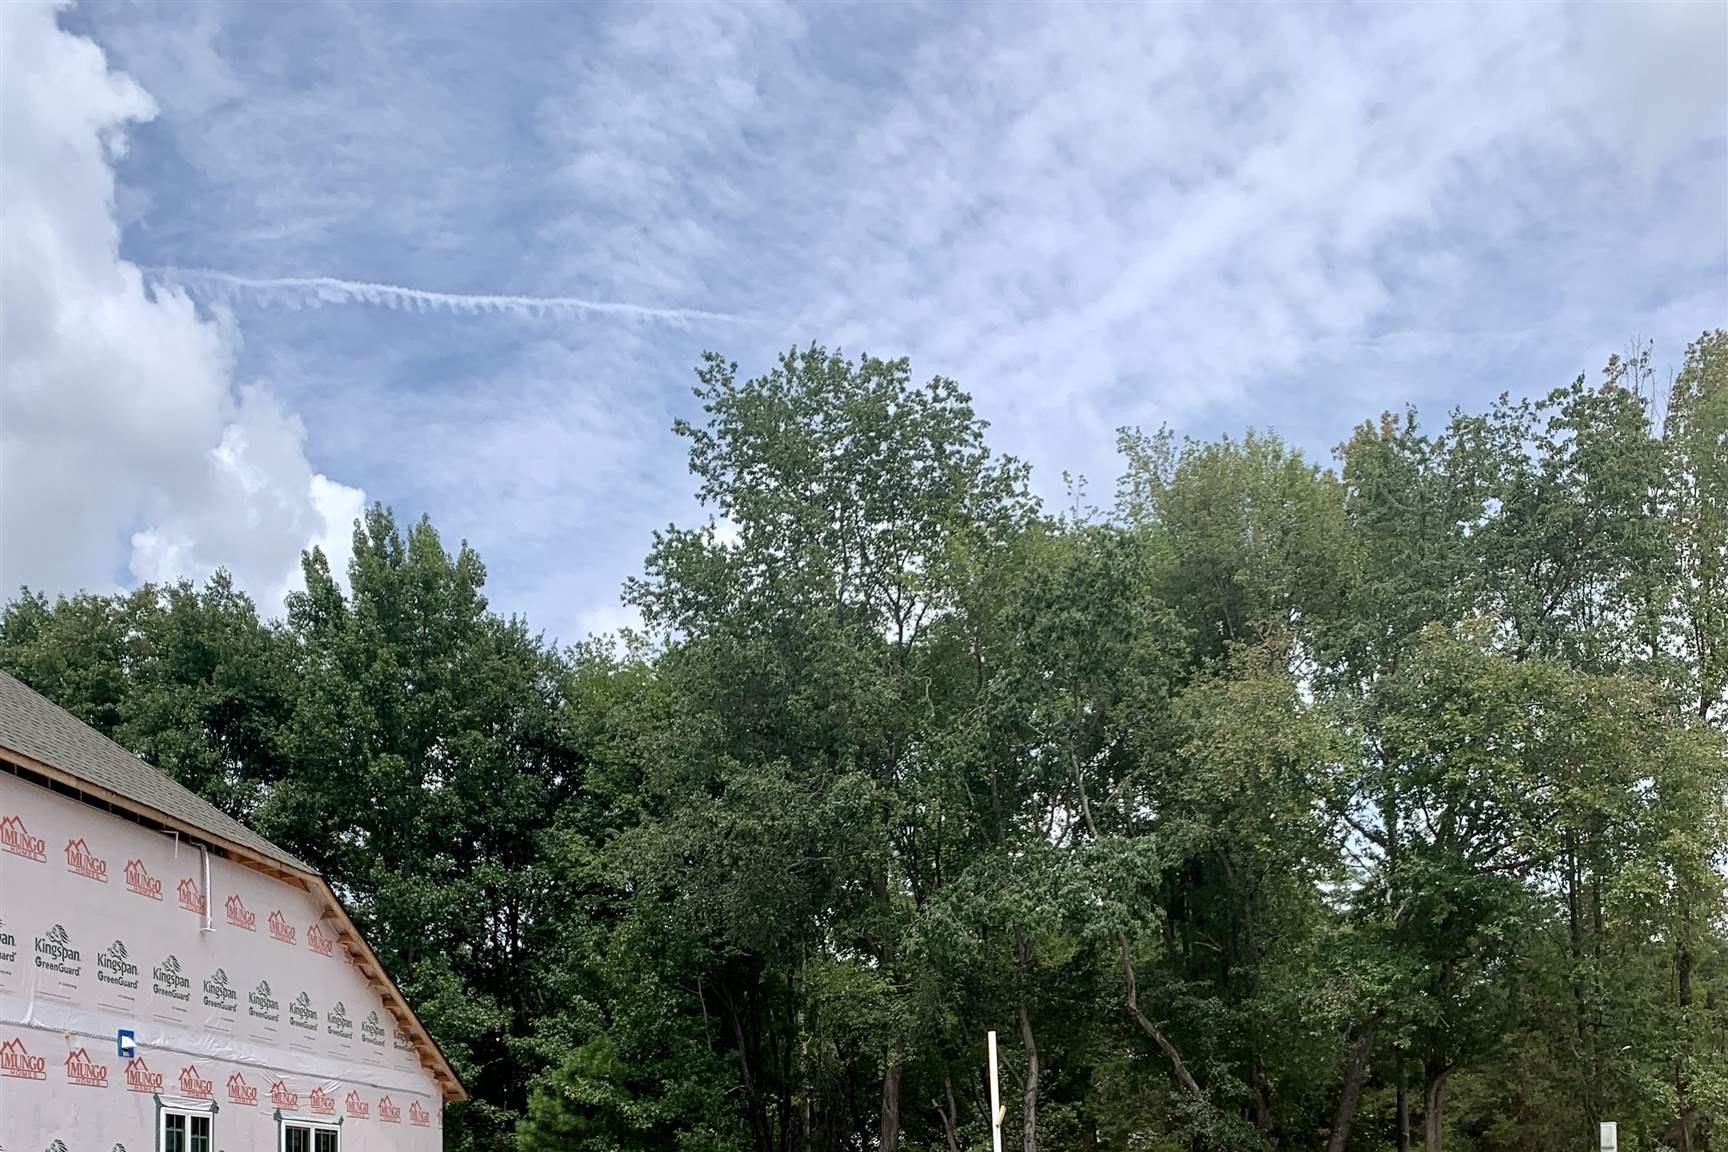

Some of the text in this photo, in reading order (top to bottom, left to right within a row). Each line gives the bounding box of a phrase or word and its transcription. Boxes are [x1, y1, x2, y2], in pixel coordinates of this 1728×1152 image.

[4, 828, 45, 854] MUNGO
[71, 851, 107, 875] MUNGO
[129, 871, 161, 893] MUNGO
[182, 890, 206, 908] MUNG
[34, 937, 80, 962] Kingspan
[35, 956, 80, 976] GreenGuard
[97, 953, 138, 976] Kingspan
[97, 970, 138, 989] GreenGuard
[153, 967, 190, 988] Kingspan
[153, 983, 190, 1001] GreenGuard
[203, 980, 237, 1000] Kingspan
[4, 1053, 45, 1072] MUNGO
[71, 1062, 107, 1080] MUNGO
[129, 1070, 162, 1088] MUNGO
[183, 1078, 212, 1093] MUNGO
[231, 1085, 257, 1100] MUNGO
